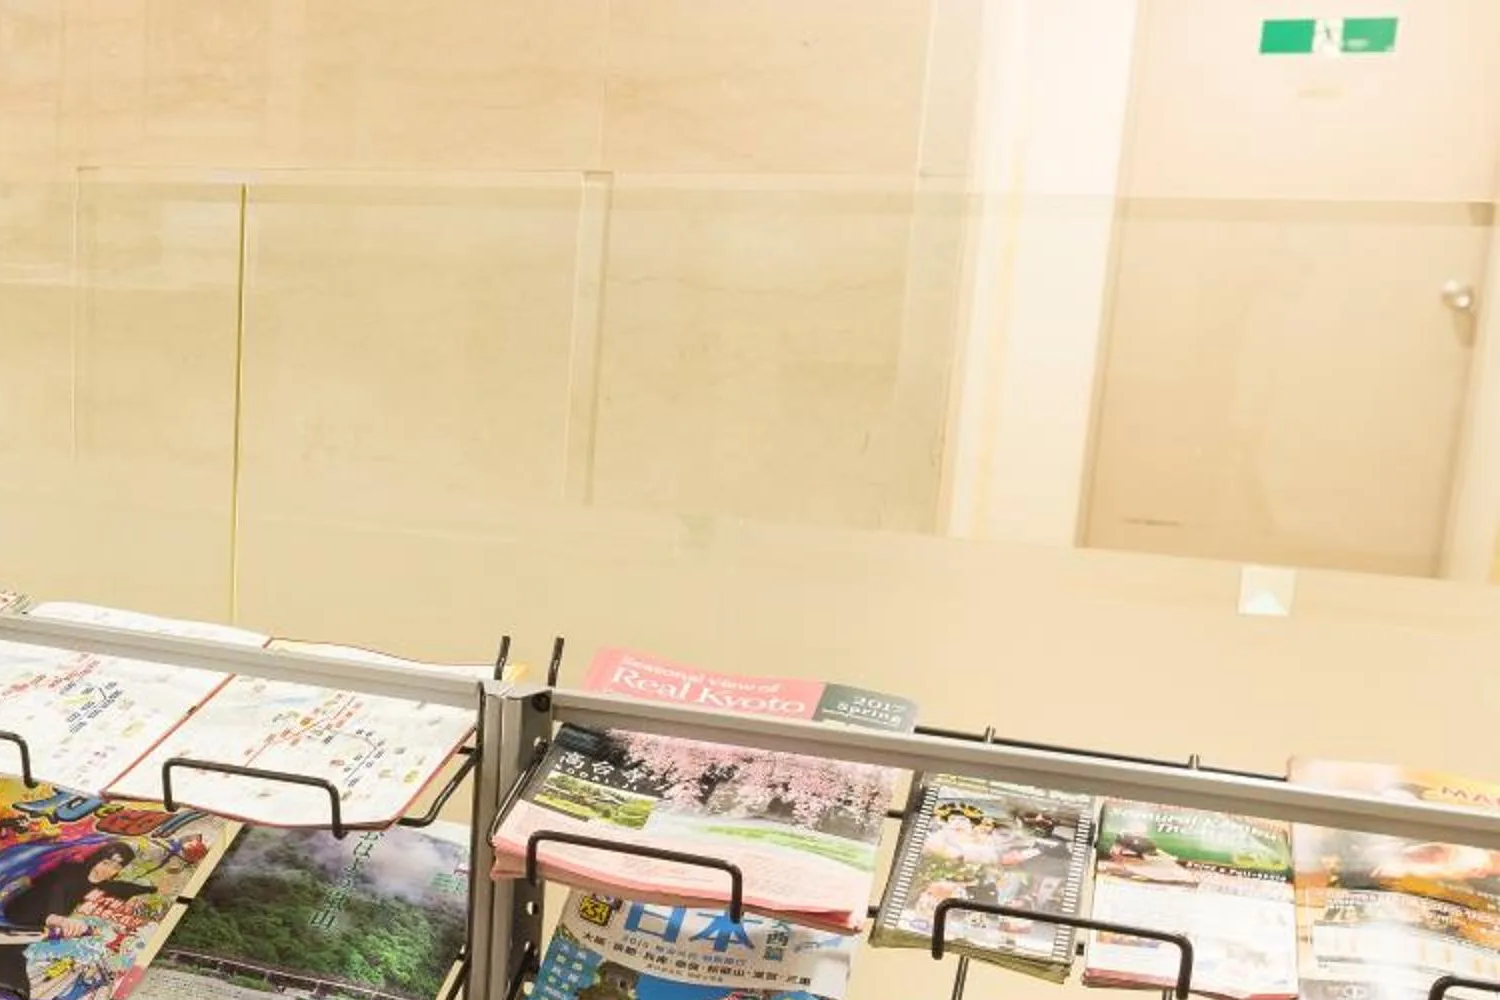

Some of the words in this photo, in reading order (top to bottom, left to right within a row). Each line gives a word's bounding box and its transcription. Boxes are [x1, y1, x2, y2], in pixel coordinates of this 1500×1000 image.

[611, 666, 692, 701] Real
[699, 686, 806, 716] Kyoto
[852, 694, 908, 714] 2017
[836, 700, 903, 726] Spring
[625, 901, 755, 952] 日本
